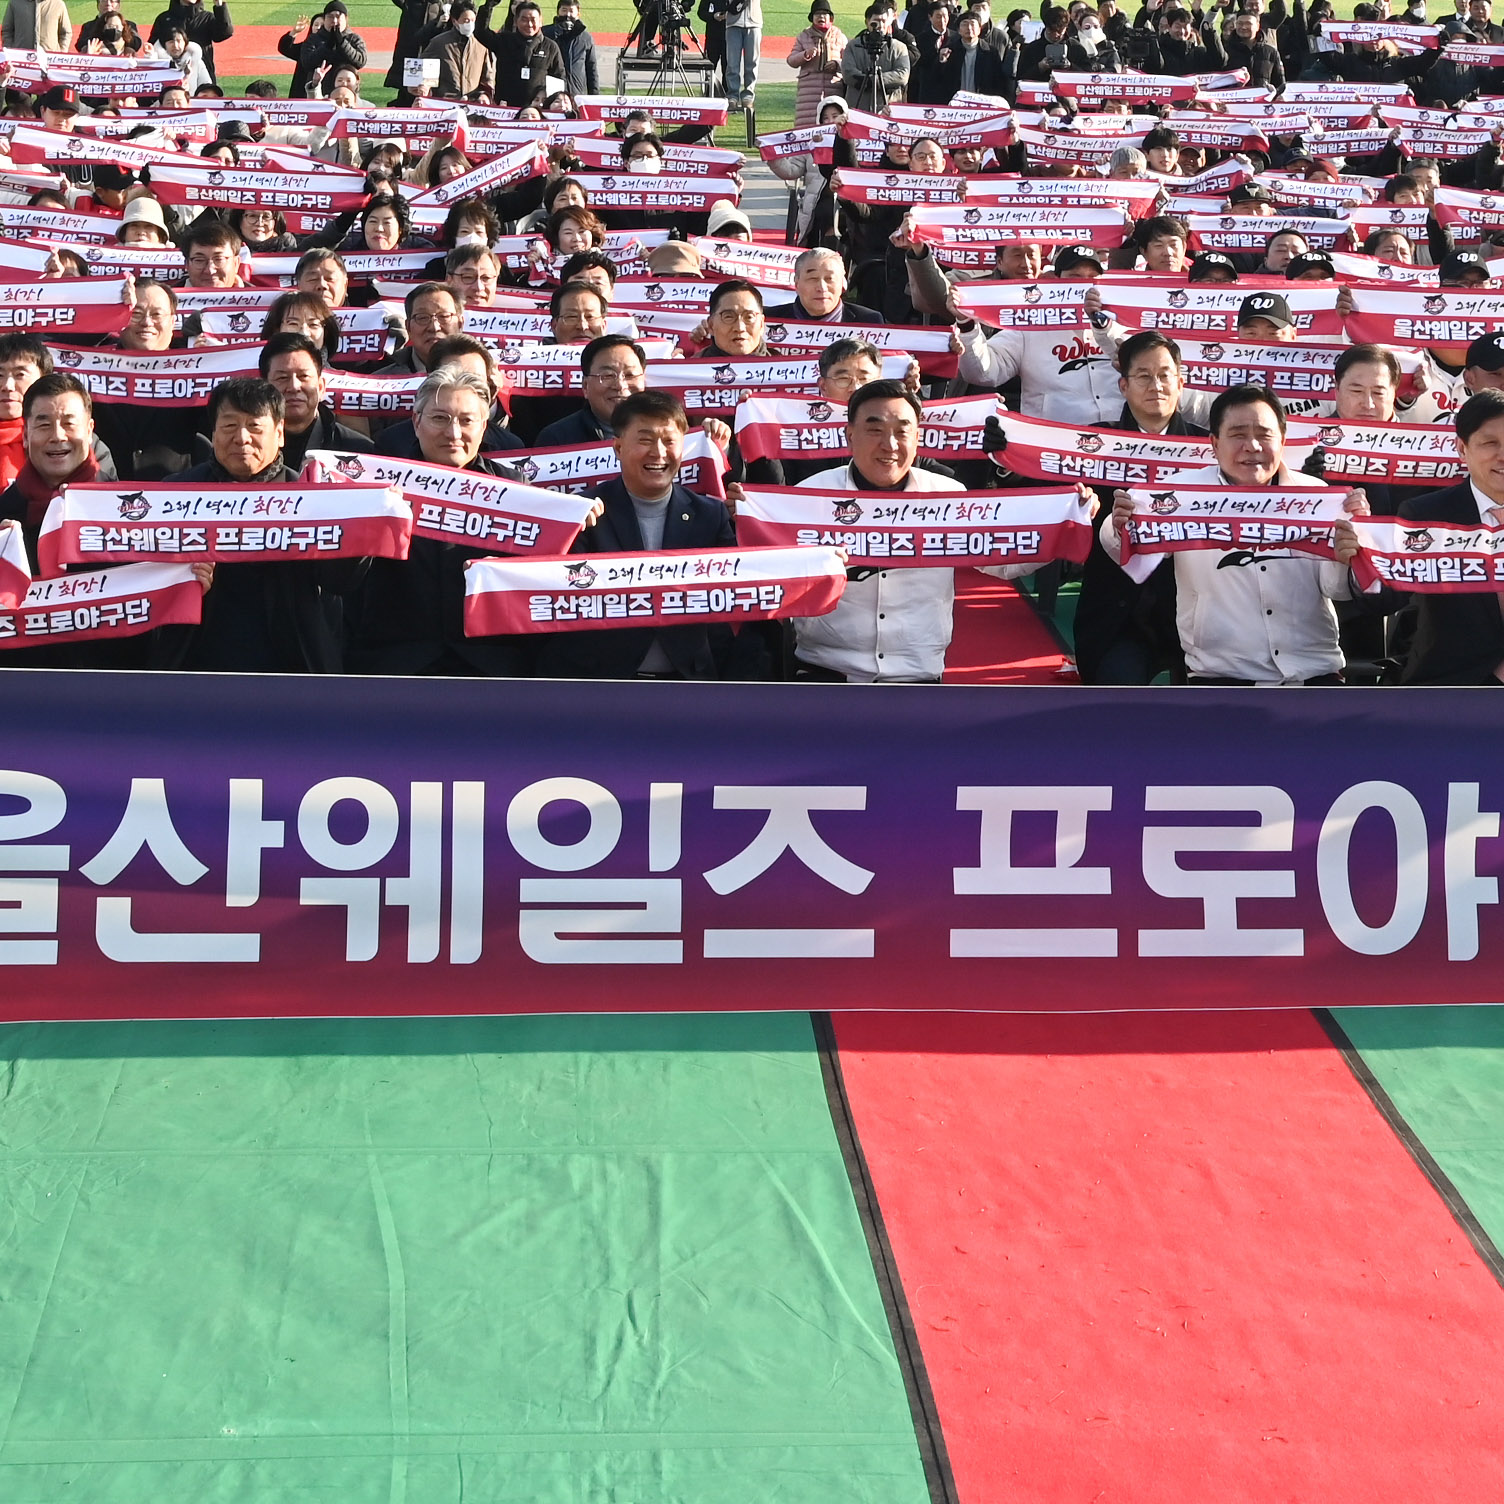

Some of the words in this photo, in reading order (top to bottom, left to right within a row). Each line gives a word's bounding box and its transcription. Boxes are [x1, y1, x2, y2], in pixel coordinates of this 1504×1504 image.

[1076, 83, 1123, 98] 울산웨일즈
[1125, 84, 1172, 98] 프로야구단
[600, 106, 650, 121] 울산웨일즈
[653, 108, 701, 123] 프로야구단
[346, 120, 403, 135] 울산웨일즈
[406, 120, 458, 135] 프로야구단
[185, 187, 256, 206] 울산웨일즈
[260, 192, 332, 210] 프로야구단
[646, 192, 706, 209] 프로야구단
[942, 226, 1016, 244] 울산웨일즈
[1018, 228, 1091, 244] 프로야구단
[998, 307, 1085, 327] 울산웨일즈
[1140, 311, 1226, 332] 울산웨일즈
[1393, 318, 1486, 341] 울산웨일즈
[1039, 452, 1148, 484] 울산웨일즈
[375, 466, 410, 487] 그래!
[416, 473, 455, 495] 역시!
[460, 478, 508, 504] 최강!
[162, 497, 198, 517] 그래!
[206, 497, 245, 516] 역시!
[254, 495, 300, 516] 최강!
[416, 505, 540, 547] 프로야구단
[78, 525, 207, 553] 울산웨일즈
[215, 524, 342, 552] 프로야구단
[922, 530, 1041, 557] 프로야구단
[1444, 530, 1480, 549] 그래!
[608, 562, 642, 582] 그래!
[648, 562, 688, 581] 역시!
[1371, 553, 1488, 582] 울산웨일즈
[528, 592, 653, 622] 울산웨일즈
[660, 585, 783, 616] 프로야구단
[25, 597, 151, 634] 프로야구단
